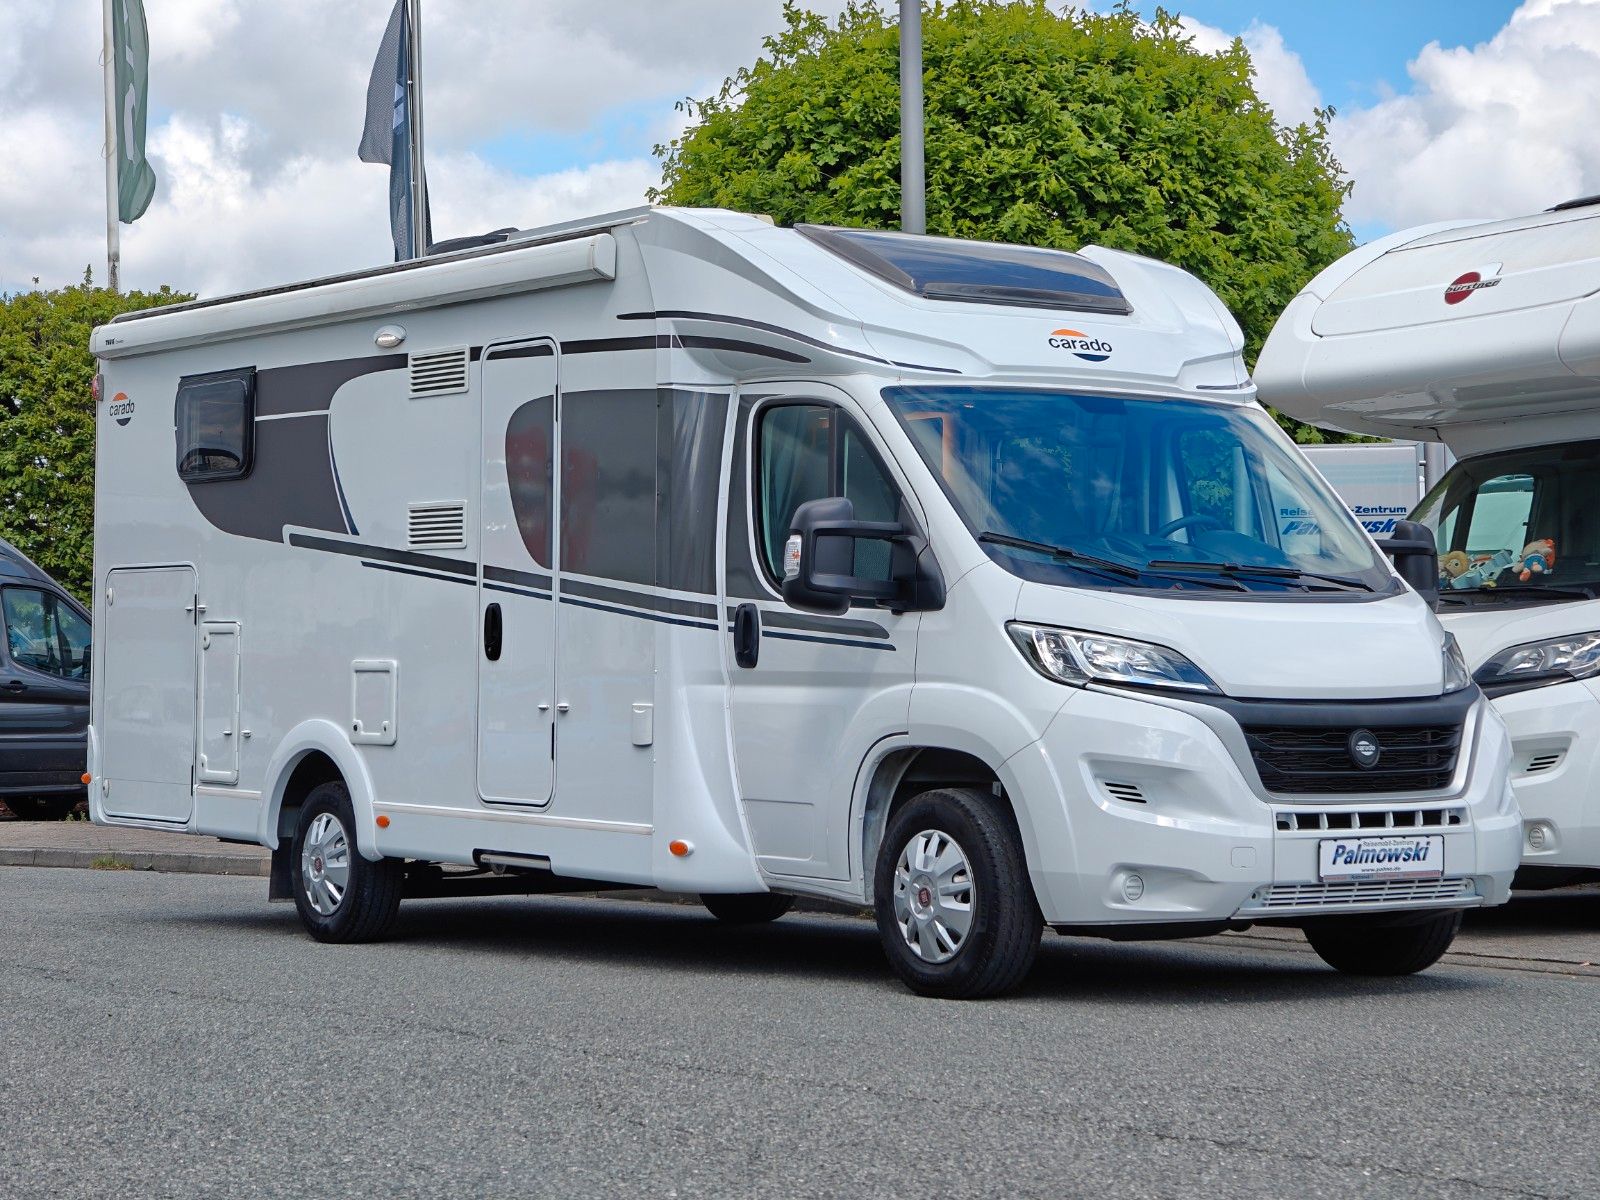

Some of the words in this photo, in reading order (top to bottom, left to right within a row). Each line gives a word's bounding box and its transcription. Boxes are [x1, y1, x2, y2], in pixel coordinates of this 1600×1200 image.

[1048, 338, 1113, 352] carado
[109, 400, 135, 416] carado
[1332, 841, 1431, 865] Palmowski
